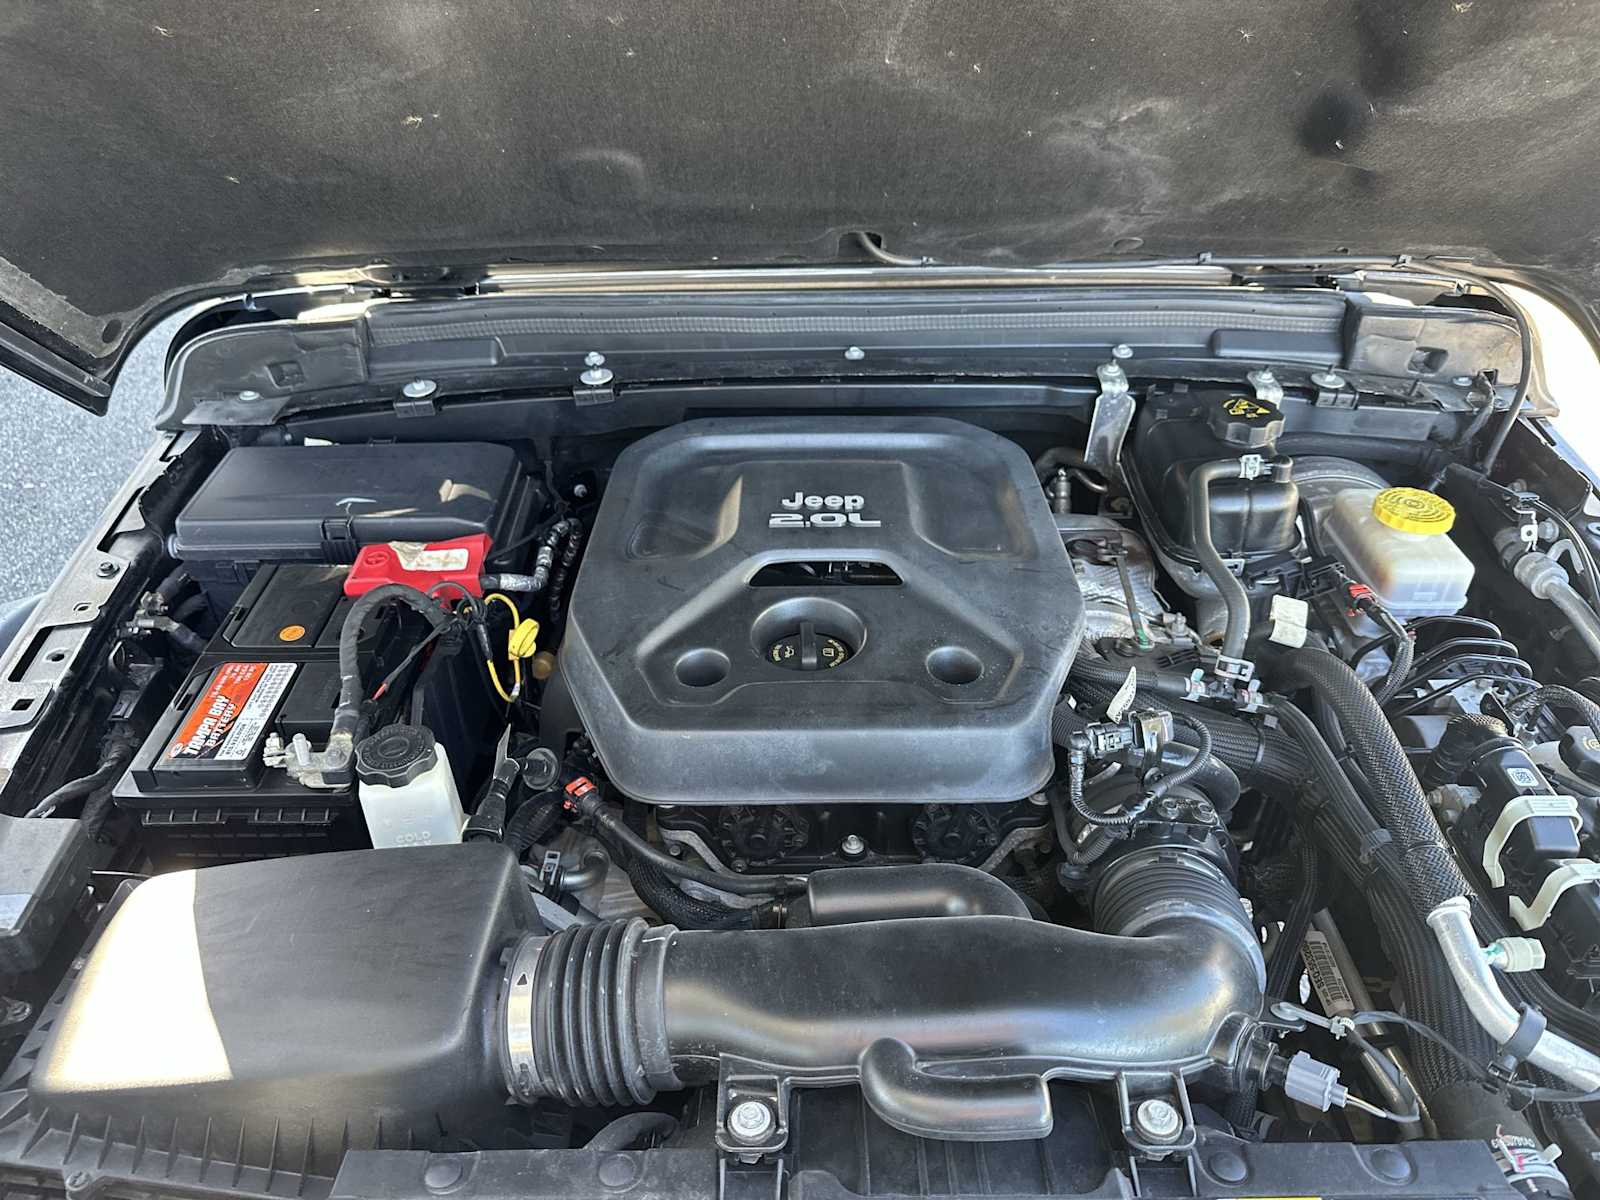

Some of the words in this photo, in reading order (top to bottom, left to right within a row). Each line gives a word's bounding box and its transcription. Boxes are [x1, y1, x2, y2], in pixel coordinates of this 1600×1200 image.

[782, 492, 864, 512] Jeep
[769, 513, 881, 528] 2.0L
[182, 717, 218, 755] TAMPA
[209, 695, 230, 717] BAY
[204, 703, 236, 747] BATTERY
[395, 830, 431, 843] COLD
